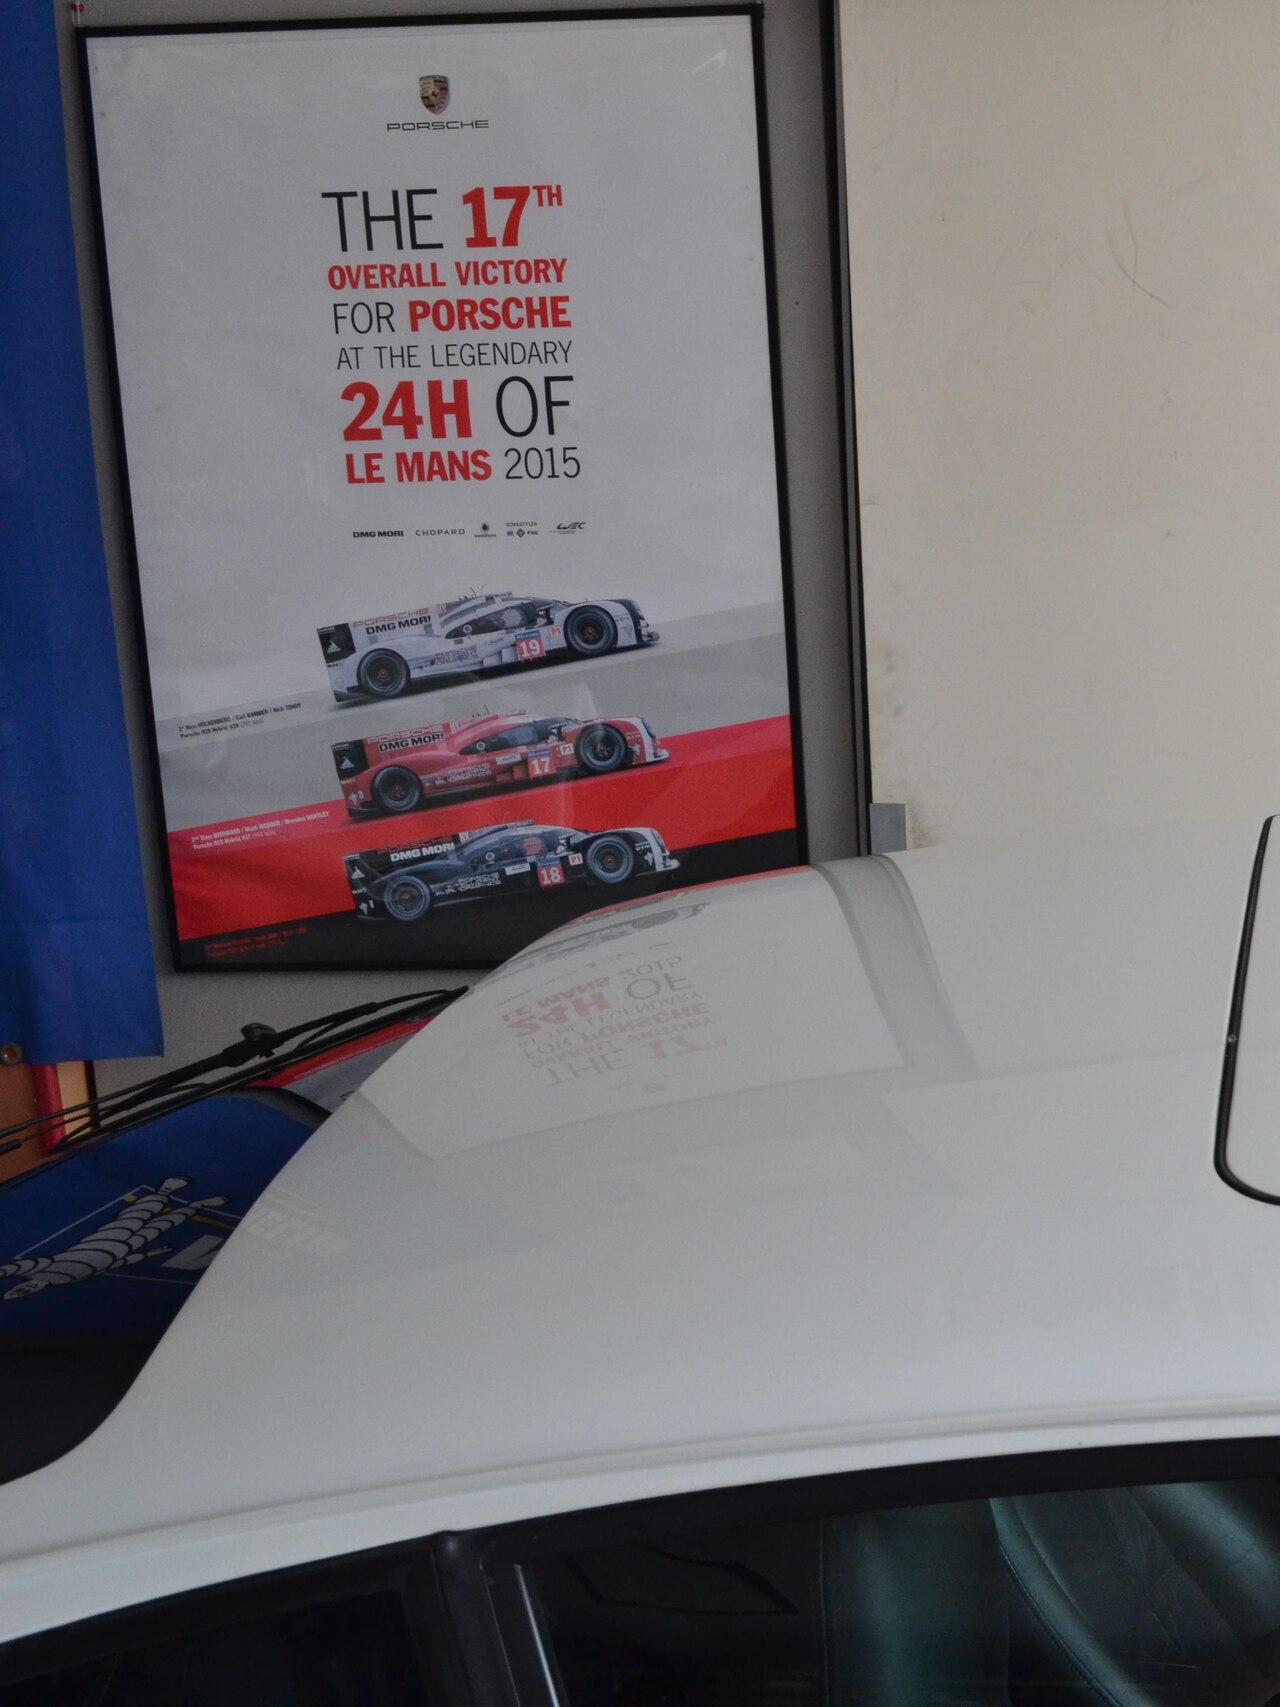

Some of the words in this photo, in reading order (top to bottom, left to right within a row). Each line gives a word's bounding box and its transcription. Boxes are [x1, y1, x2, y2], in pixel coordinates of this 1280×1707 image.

[386, 119, 489, 132] PORSCHE
[321, 188, 444, 252] THE
[462, 184, 563, 249] 17TH
[327, 262, 446, 291] OVERALL
[454, 257, 567, 286] VICTORY
[333, 301, 396, 335] FOR
[408, 295, 572, 333] PORSCHE
[337, 346, 363, 370] AT
[373, 344, 421, 369] THE
[431, 340, 573, 367] LEGENDARY
[340, 378, 472, 442] 24H
[495, 375, 574, 438] OF
[345, 452, 385, 485] LE
[395, 449, 493, 483] MANS
[503, 446, 581, 480] 2015
[352, 530, 376, 539] DMG
[377, 529, 404, 538] MORI
[415, 528, 466, 537] CHOPARD
[352, 607, 430, 628] PORSCHE
[365, 622, 396, 635] DMG
[398, 615, 431, 629] MORI
[518, 638, 541, 658] 19
[367, 725, 444, 744] PORSCHE
[379, 741, 409, 752] DMG
[411, 733, 444, 746] MORI
[531, 757, 551, 775] 17
[390, 848, 421, 862] DMG
[422, 842, 455, 856] MORI
[541, 867, 561, 884] 18
